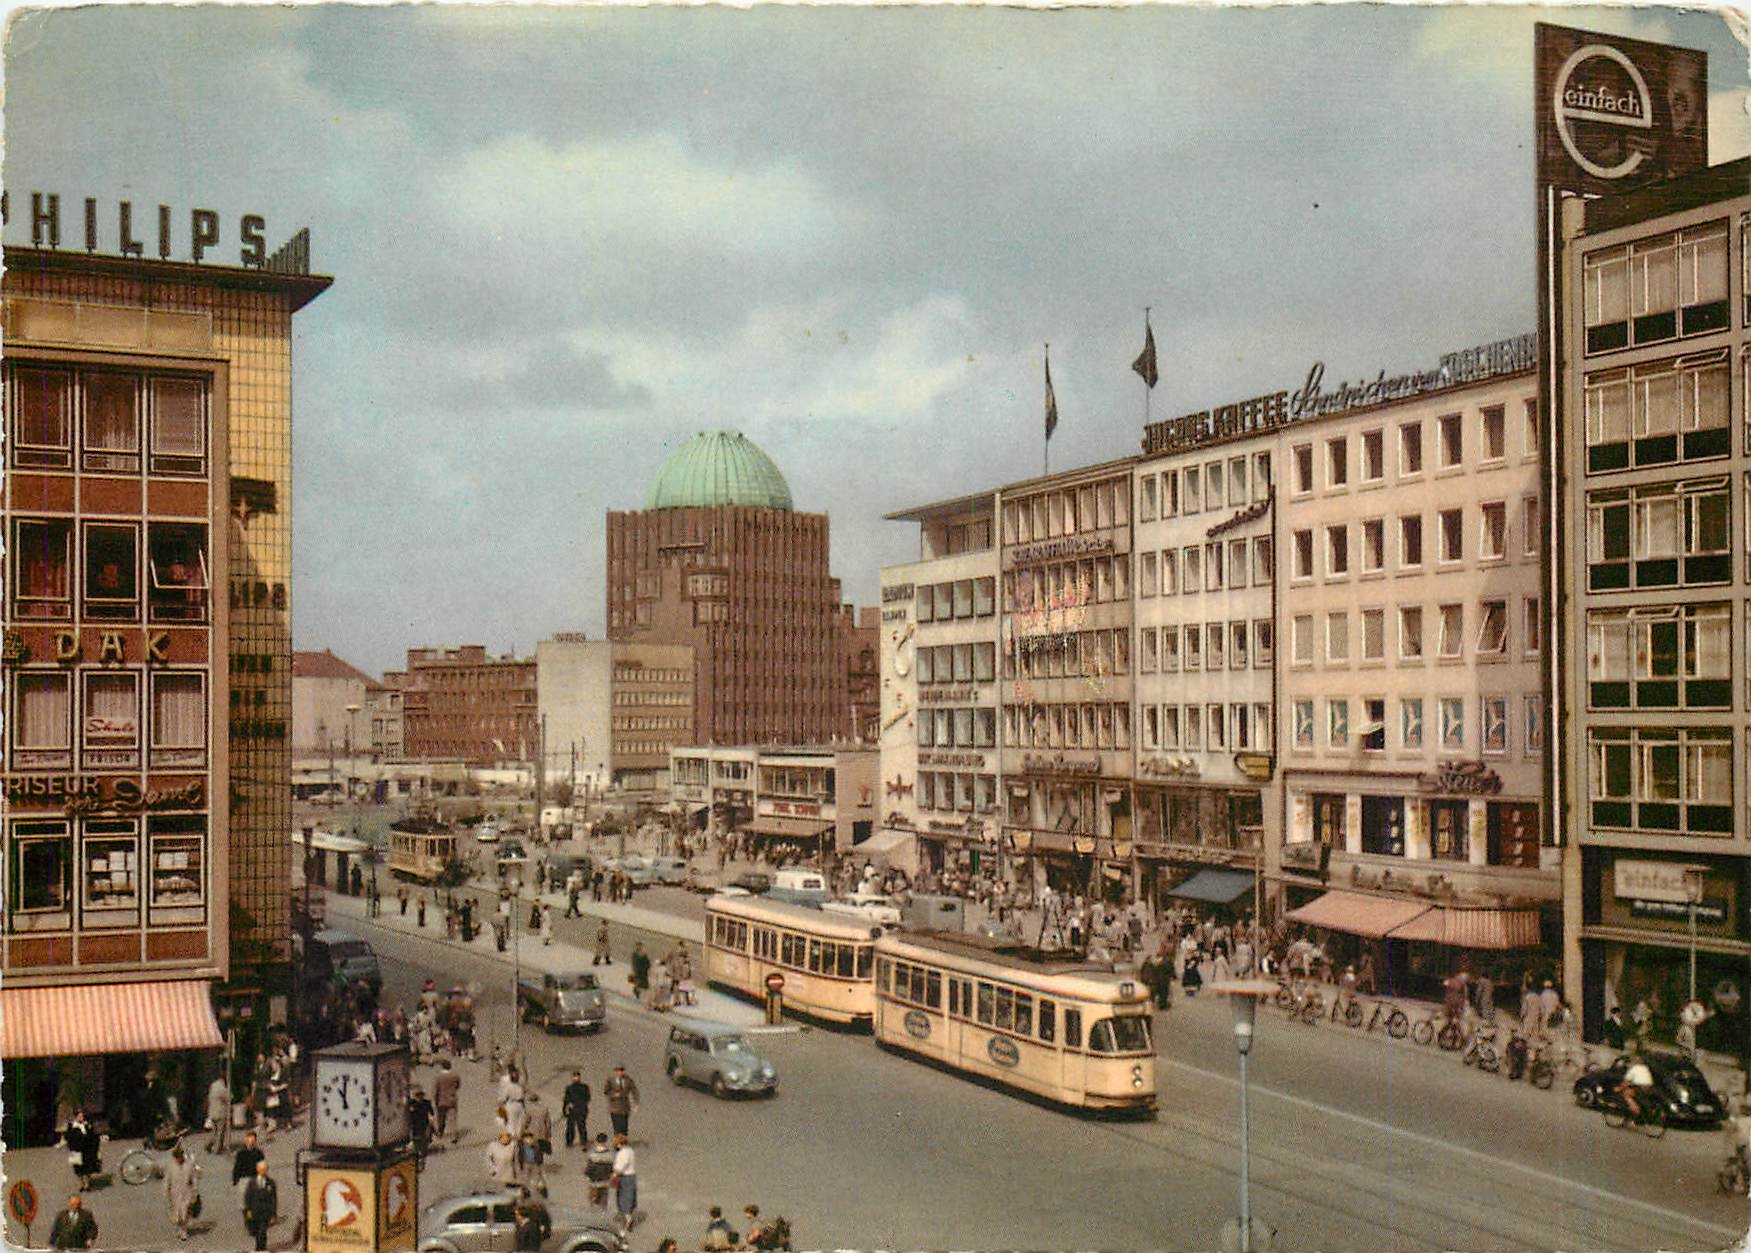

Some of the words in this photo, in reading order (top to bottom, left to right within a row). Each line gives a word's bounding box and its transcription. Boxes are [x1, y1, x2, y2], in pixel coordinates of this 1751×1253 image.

[1565, 86, 1641, 115] einfach
[1, 190, 267, 266] HILIPS
[1212, 390, 1288, 437] KAFFEE
[56, 630, 169, 660] DAK
